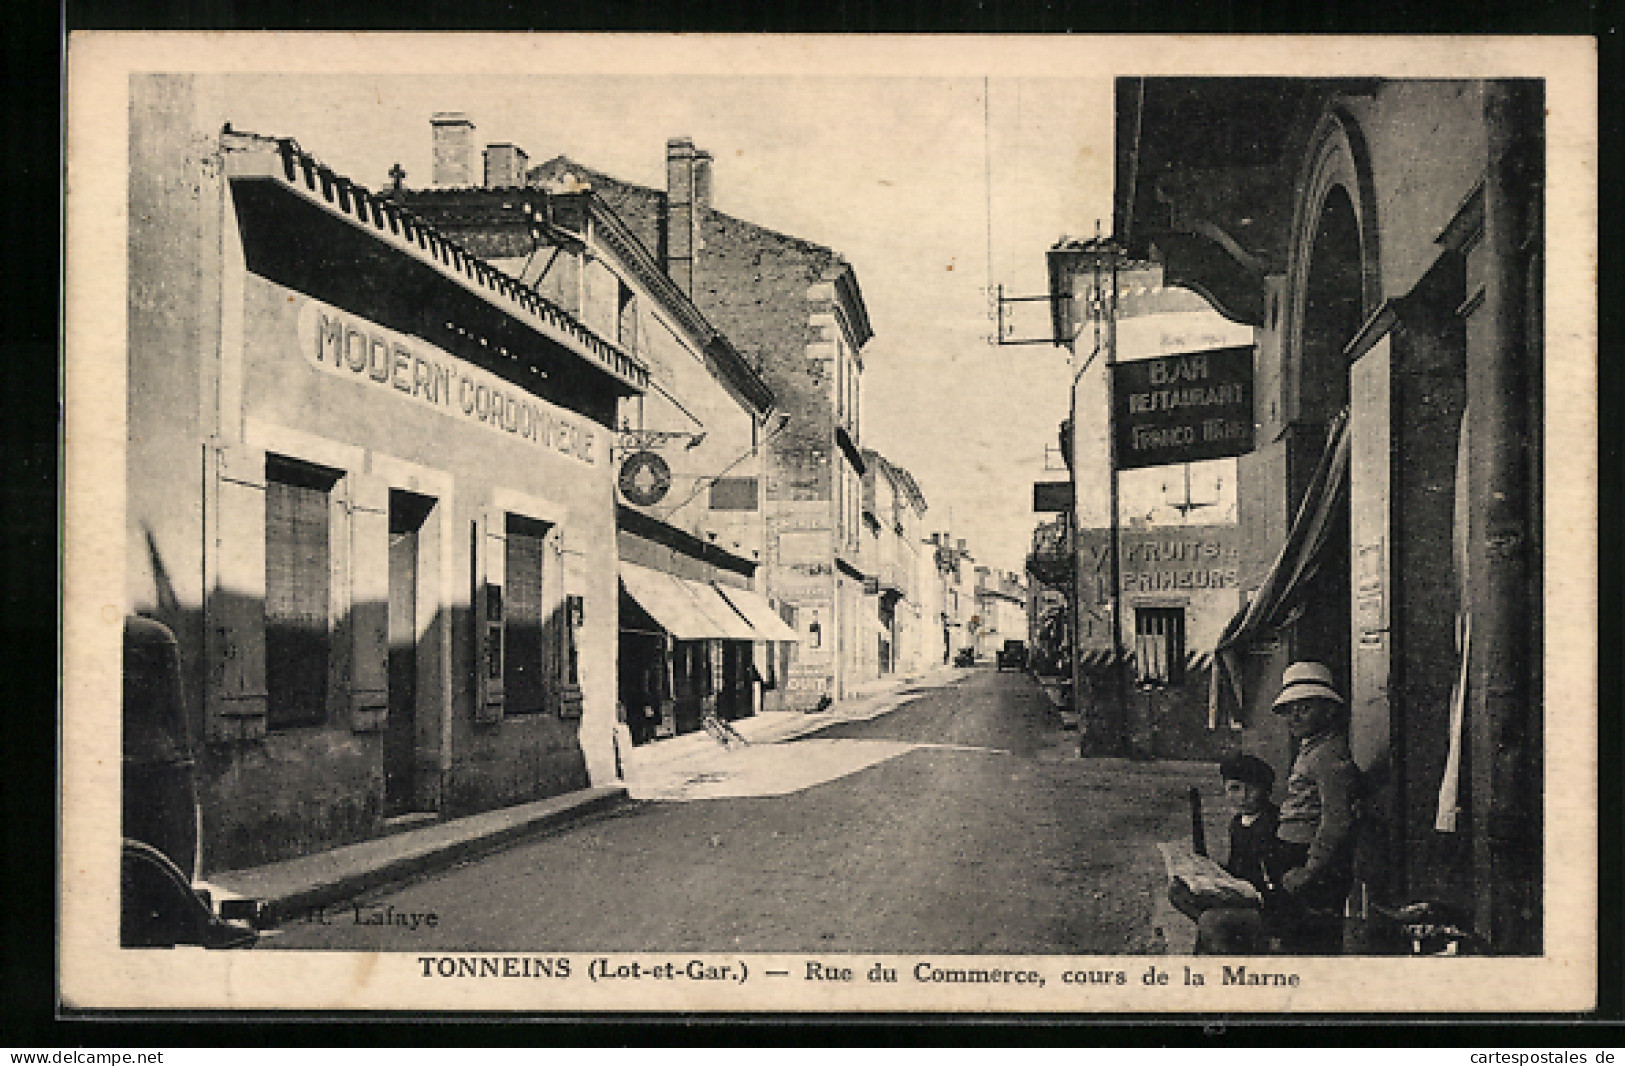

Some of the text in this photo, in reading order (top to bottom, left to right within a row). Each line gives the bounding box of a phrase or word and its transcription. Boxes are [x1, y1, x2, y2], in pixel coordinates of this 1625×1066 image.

[1149, 355, 1208, 384] BAR
[1129, 383, 1243, 414] RESTAURANT
[1126, 541, 1221, 562] FRUITS
[1122, 569, 1240, 592] PRIMEURS
